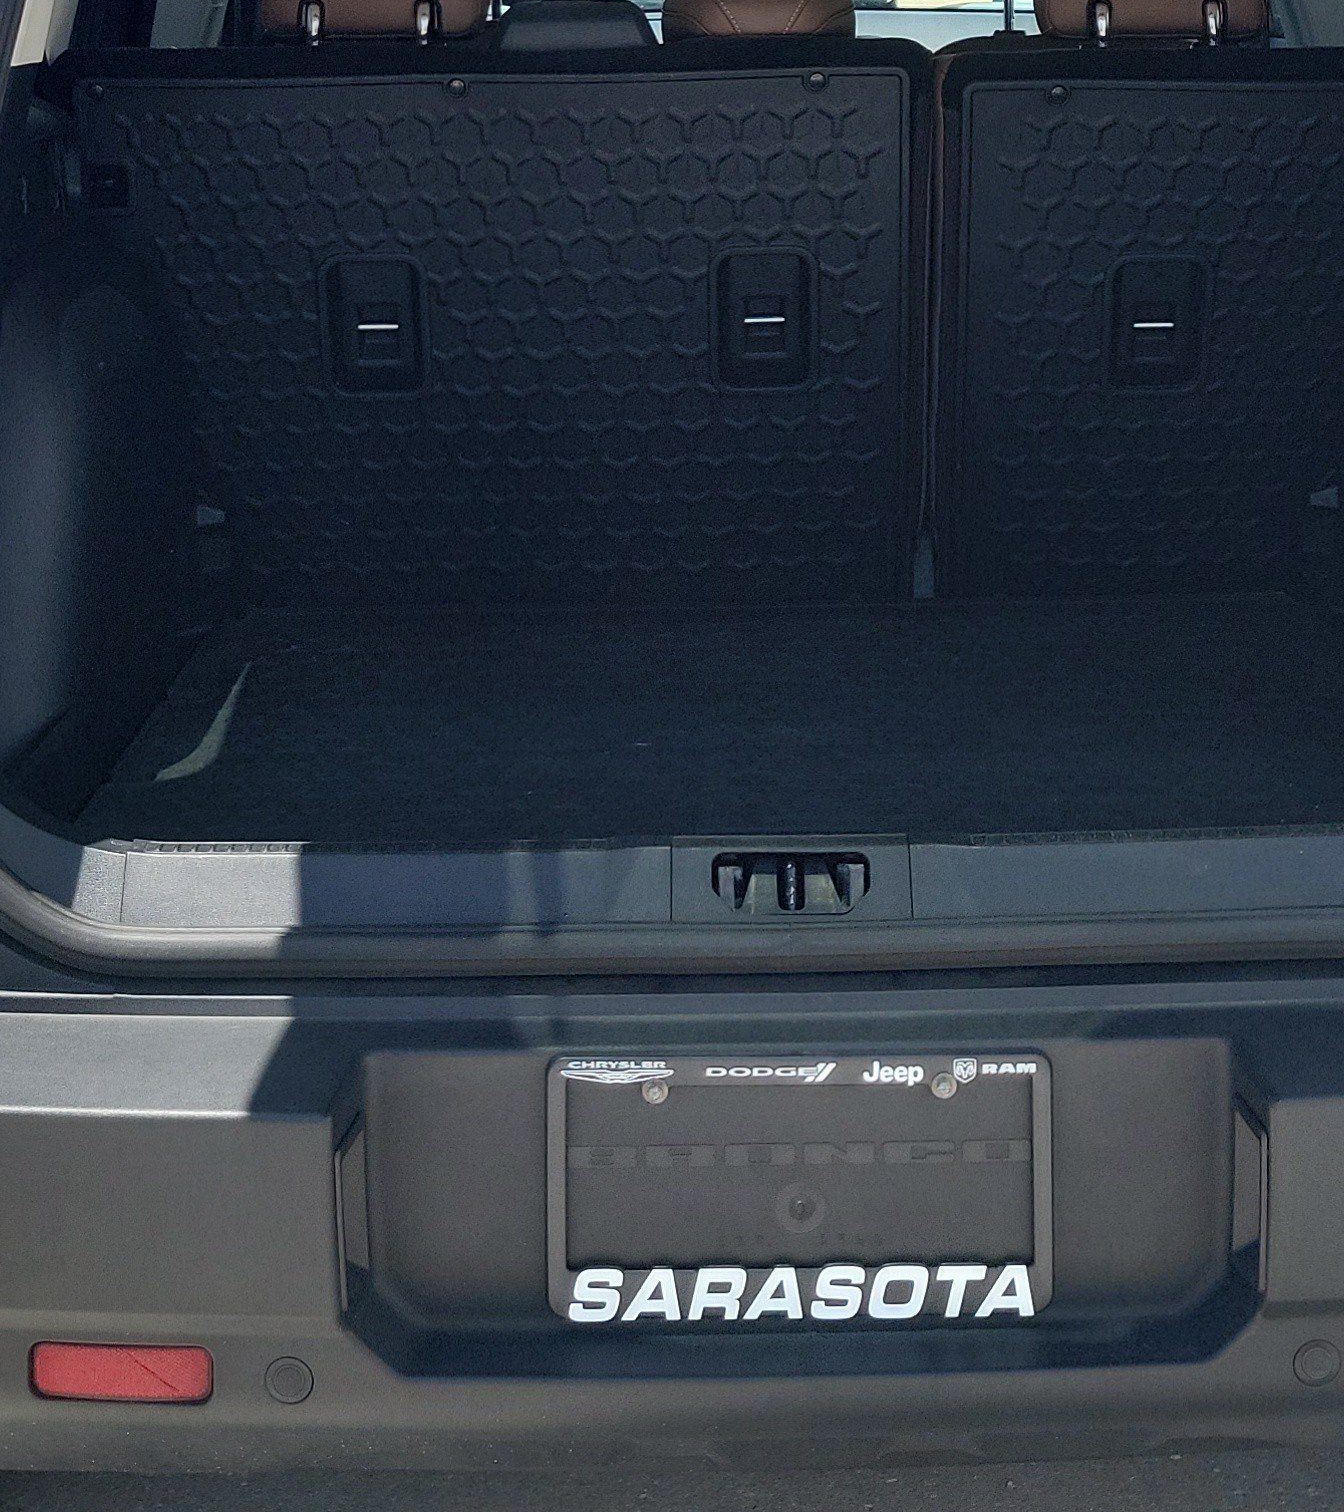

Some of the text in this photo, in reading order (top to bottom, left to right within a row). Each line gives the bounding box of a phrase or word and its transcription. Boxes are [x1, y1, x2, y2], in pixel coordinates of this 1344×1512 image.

[567, 1060, 667, 1071] CHRYSLER
[981, 1062, 1036, 1075] RAM
[704, 1067, 819, 1078] DODGE
[862, 1060, 924, 1087] Jeep
[567, 1264, 1035, 1322] SARASOTA
